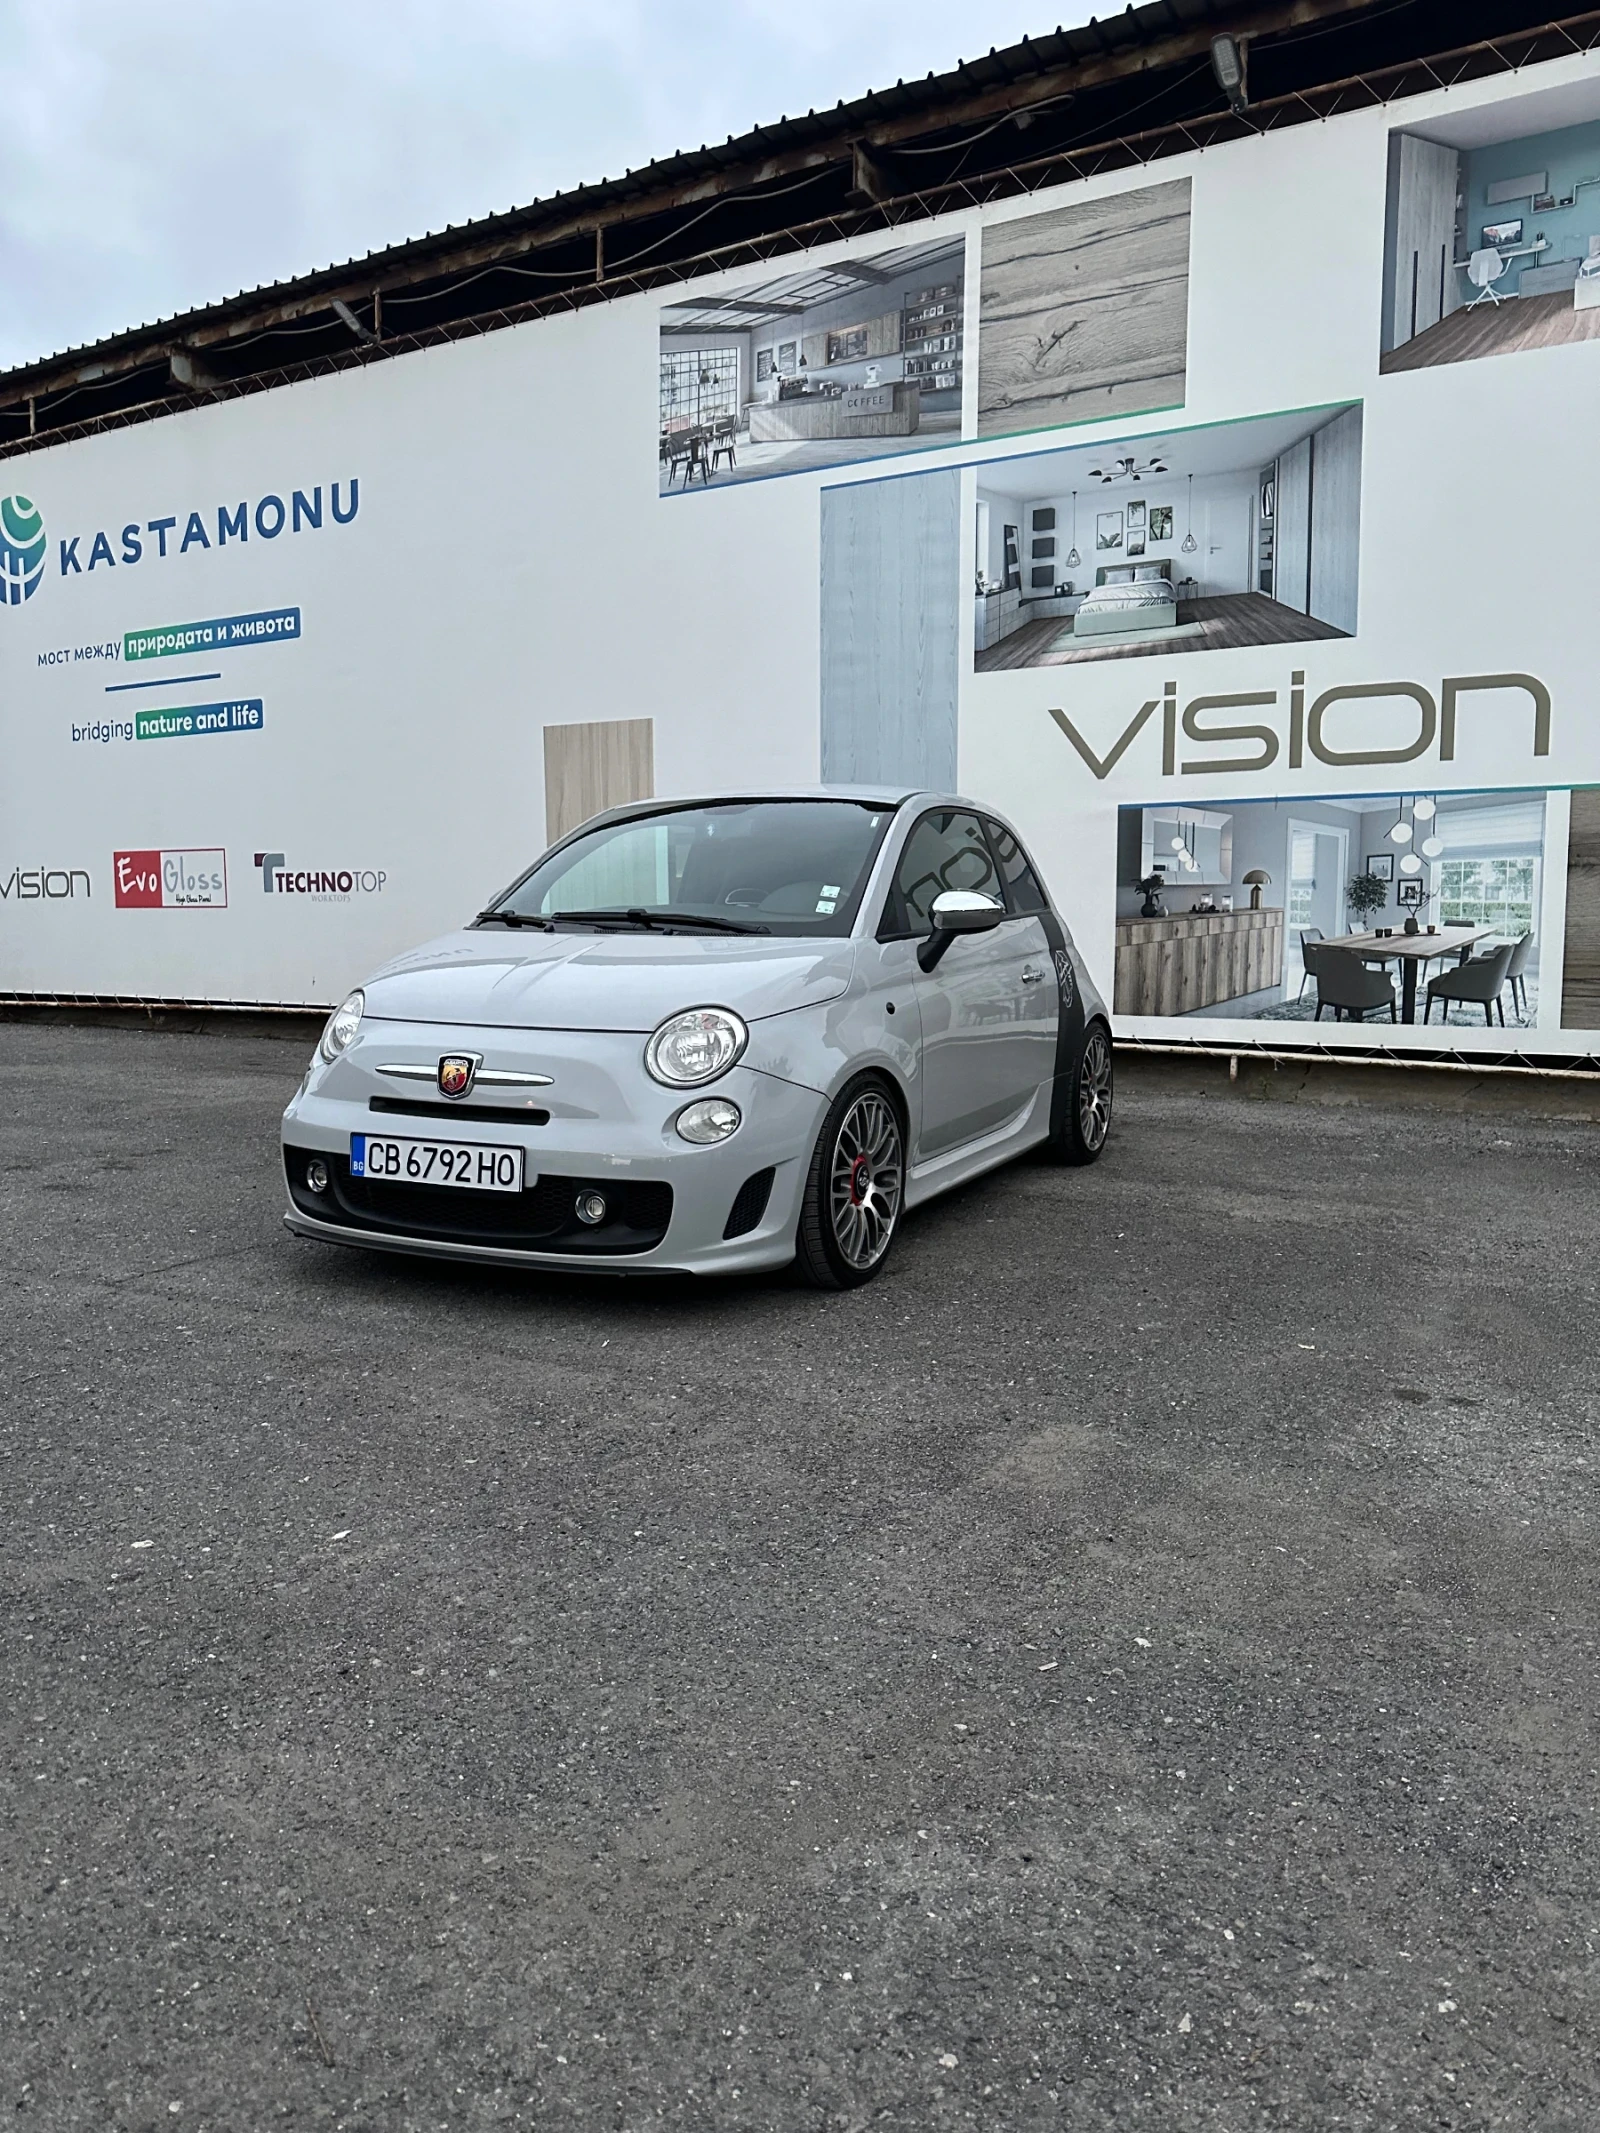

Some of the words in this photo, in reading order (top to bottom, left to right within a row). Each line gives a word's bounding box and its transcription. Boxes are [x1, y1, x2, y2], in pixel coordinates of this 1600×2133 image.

[59, 478, 360, 576] KASTAMONU
[37, 649, 70, 666] мост
[74, 641, 122, 661] между
[128, 628, 213, 658] природата
[217, 627, 227, 641] и
[231, 614, 296, 638] живота
[71, 719, 133, 744] bridging
[139, 713, 193, 736] nature
[196, 707, 228, 730] and
[232, 705, 259, 726] life
[1047, 669, 1552, 780] vision
[0, 865, 91, 900] vision
[311, 894, 351, 903] WORKTOPS
[353, 1161, 364, 1172] BG
